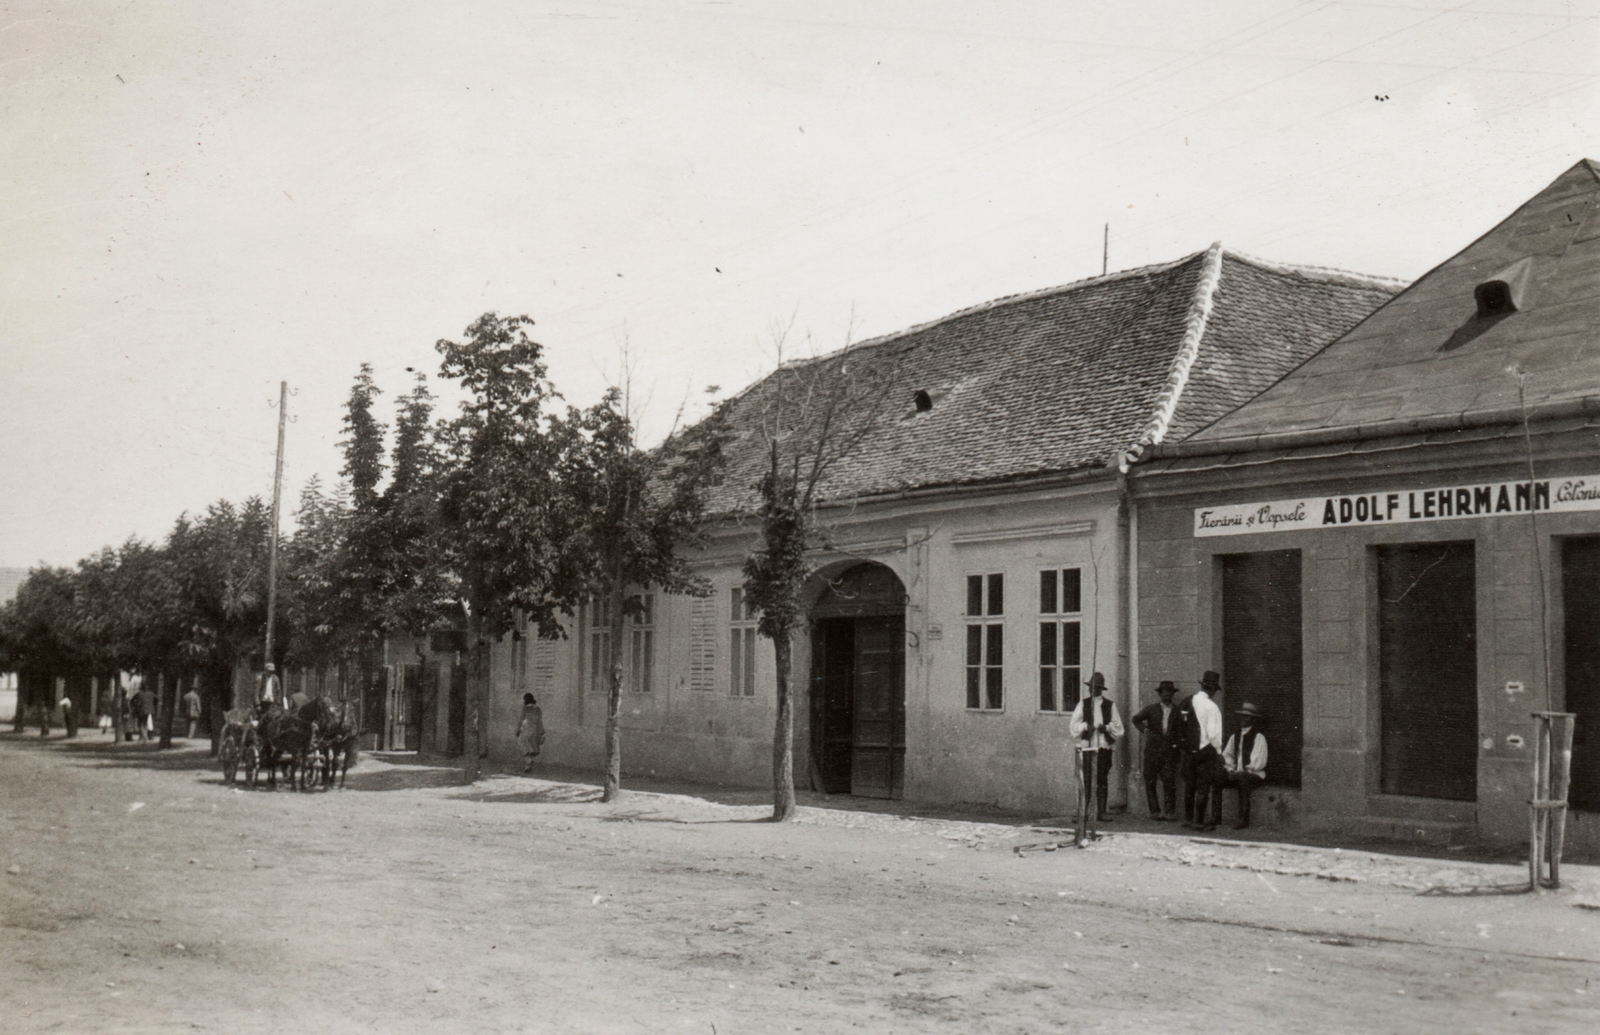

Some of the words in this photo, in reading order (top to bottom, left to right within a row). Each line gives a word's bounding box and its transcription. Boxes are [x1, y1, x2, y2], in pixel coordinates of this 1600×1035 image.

[1257, 502, 1307, 528] Vopsele
[1322, 494, 1399, 525] ADOLF
[1408, 481, 1550, 519] LEHRMANN
